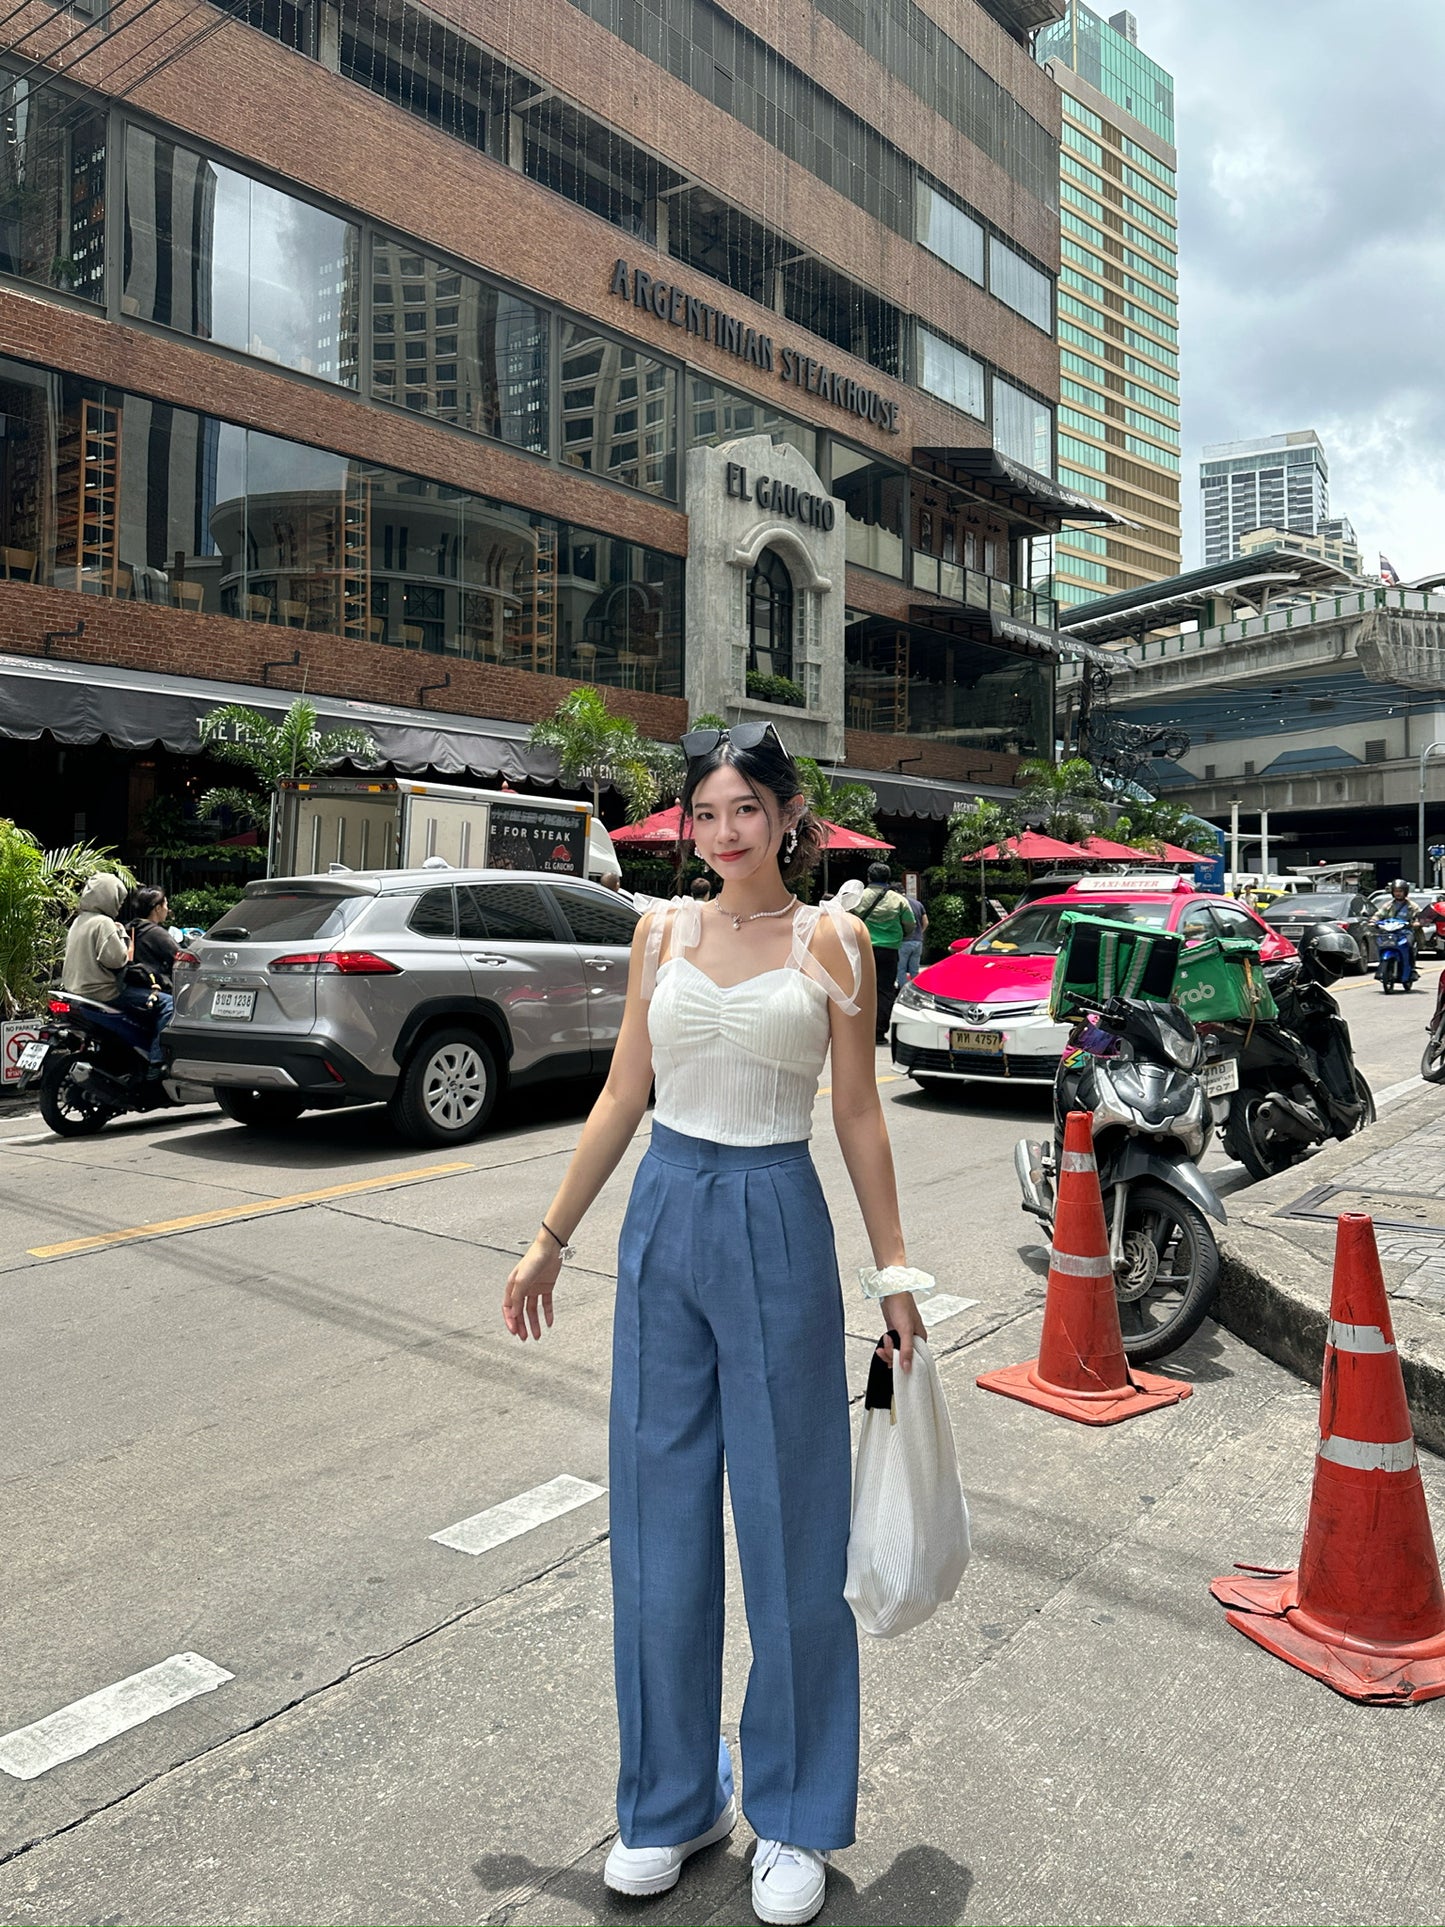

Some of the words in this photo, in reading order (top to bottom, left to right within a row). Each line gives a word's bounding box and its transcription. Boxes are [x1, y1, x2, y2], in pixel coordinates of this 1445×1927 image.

[610, 258, 774, 372] ARGENTINIAN
[781, 346, 900, 435] STEAKHOUSE
[726, 461, 753, 502] EL
[755, 475, 835, 531] GAUCHO
[503, 826, 527, 838] FOR
[533, 829, 571, 842] STEAK
[544, 861, 551, 870] EL
[552, 862, 575, 872] GAUCHO
[1179, 981, 1216, 1006] rab
[974, 1033, 998, 1046] 4757
